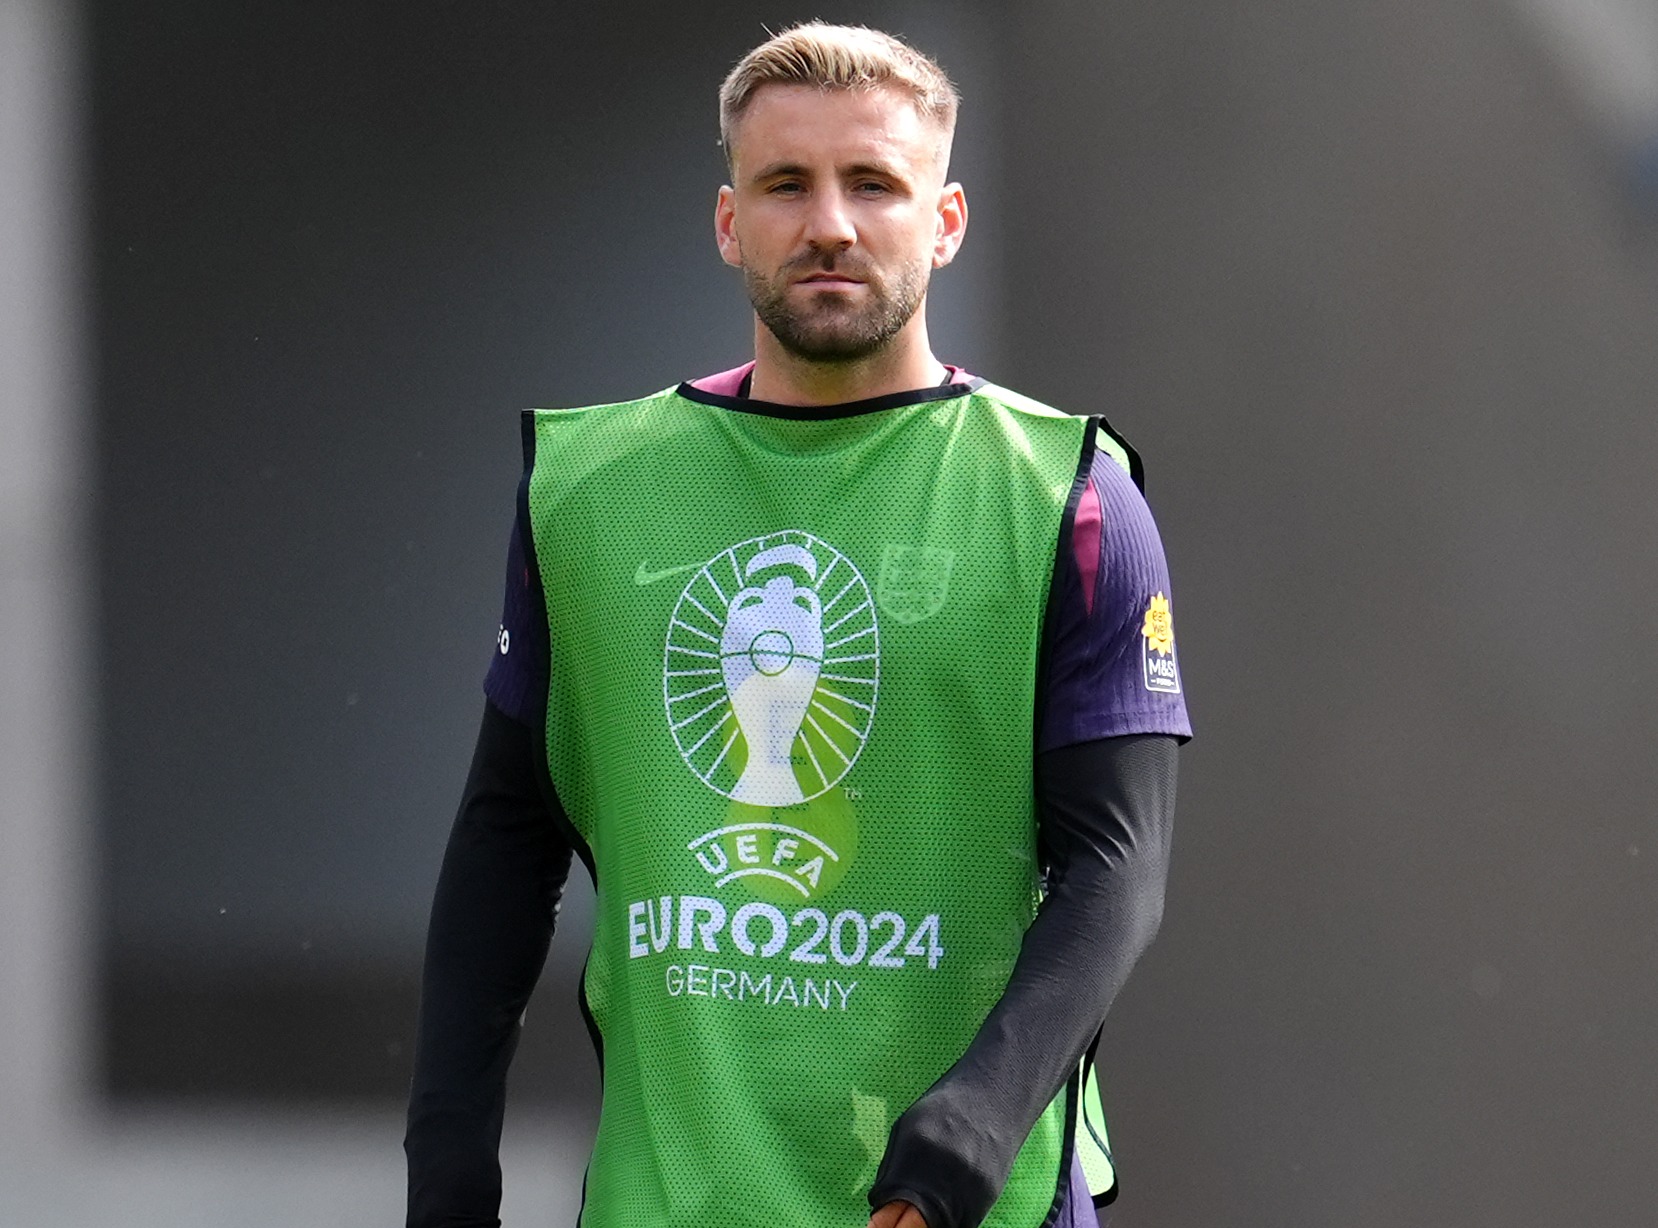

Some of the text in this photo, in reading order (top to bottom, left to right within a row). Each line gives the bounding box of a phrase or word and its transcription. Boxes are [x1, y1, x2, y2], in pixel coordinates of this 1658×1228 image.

[1148, 658, 1174, 678] M&S
[695, 834, 824, 888] UEFA
[666, 964, 858, 1011] GERMANY
